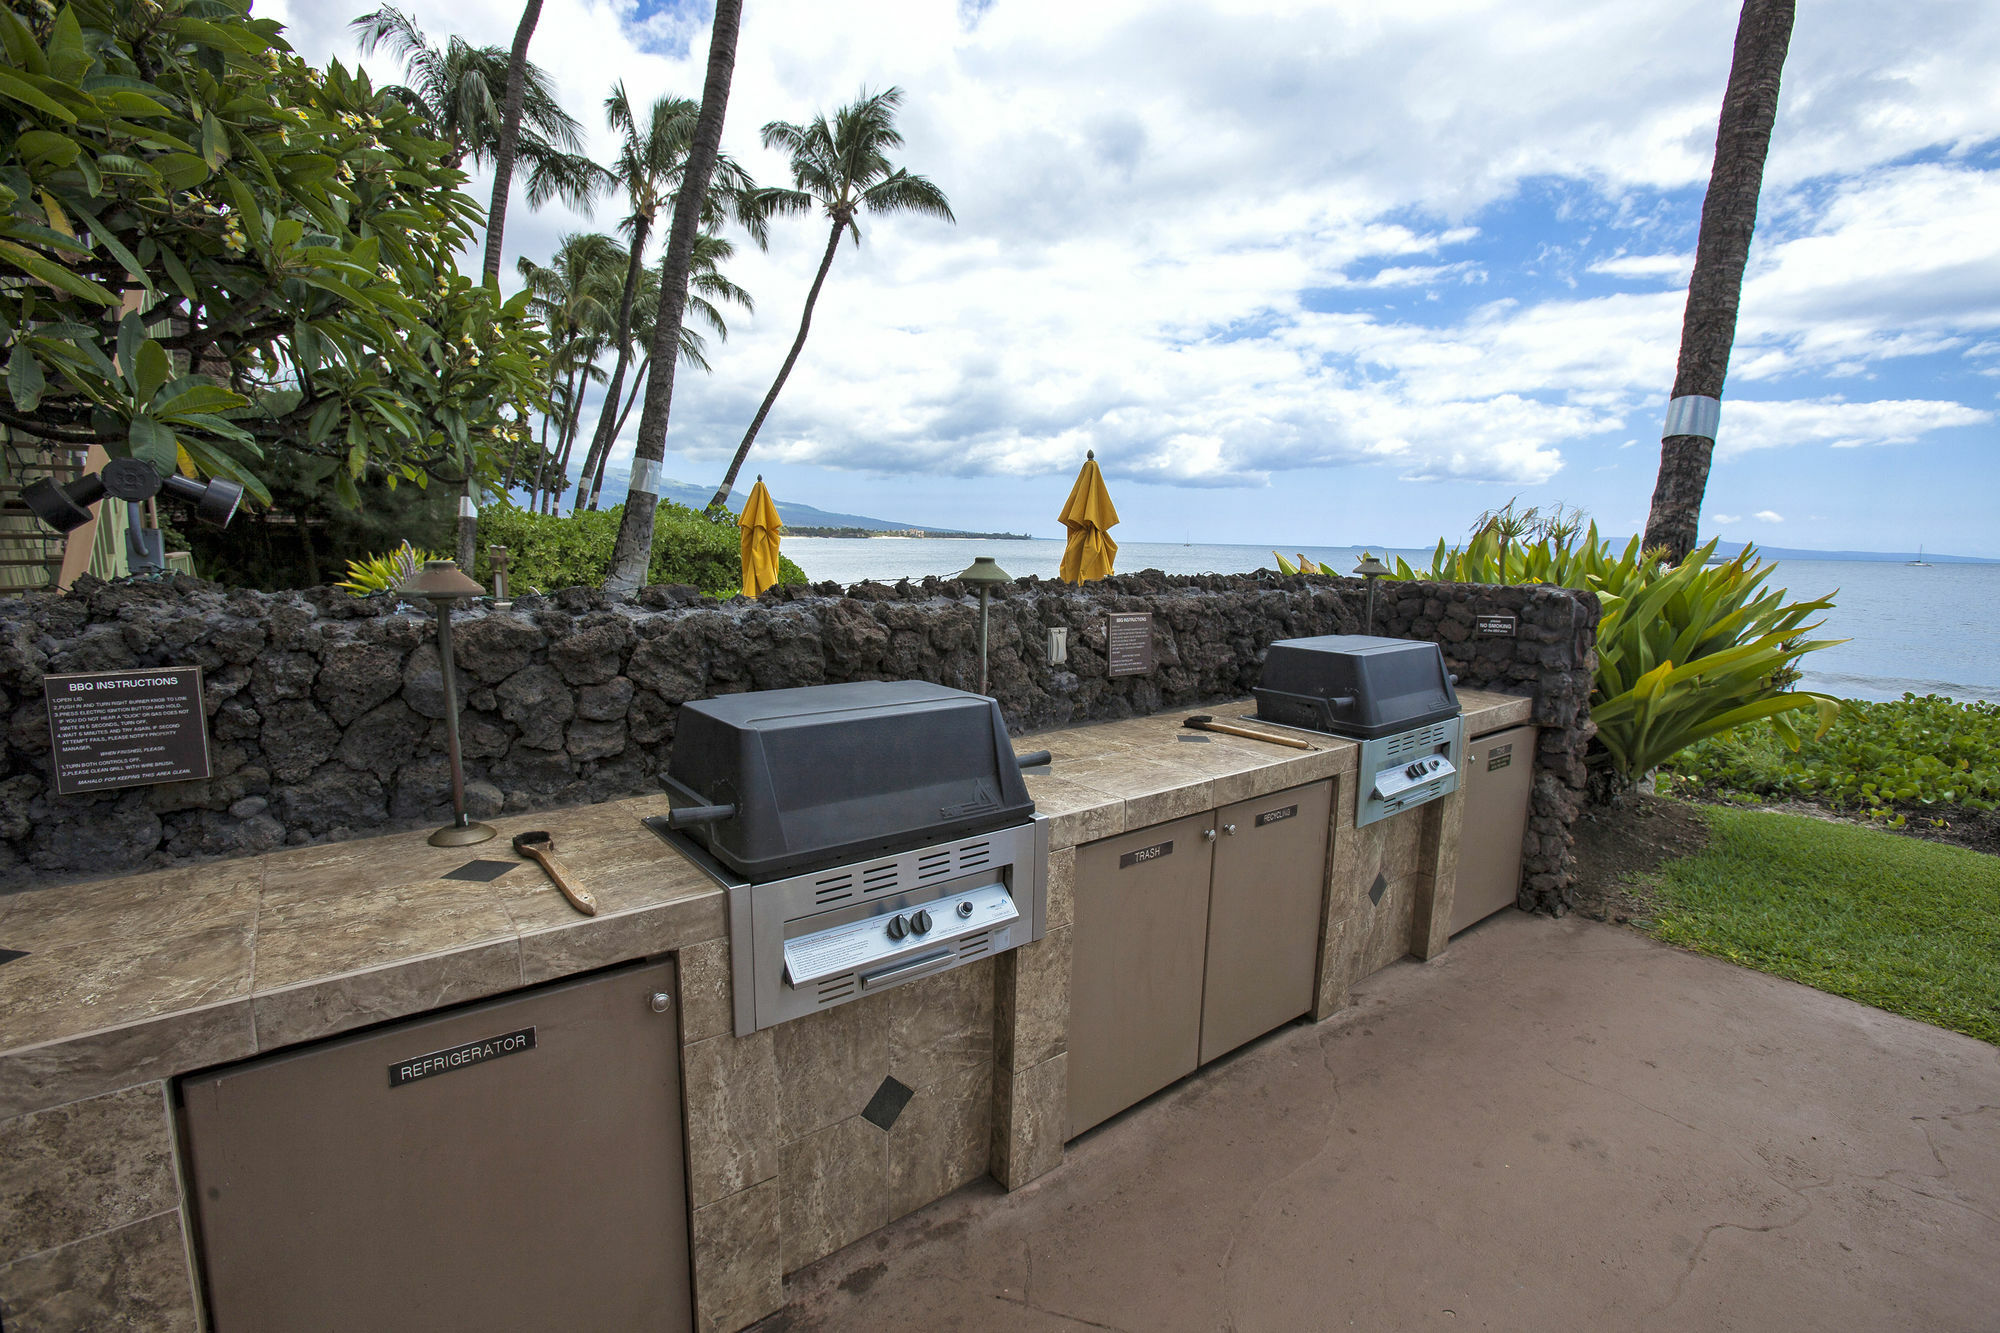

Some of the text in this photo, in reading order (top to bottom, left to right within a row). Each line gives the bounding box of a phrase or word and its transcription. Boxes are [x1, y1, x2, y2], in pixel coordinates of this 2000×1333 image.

[69, 677, 178, 692] BBQ INSTRUCTIONS
[1263, 808, 1291, 823] RECYCLING
[1134, 846, 1160, 862] TRASH
[401, 1035, 526, 1080] REFRIGERATOR
